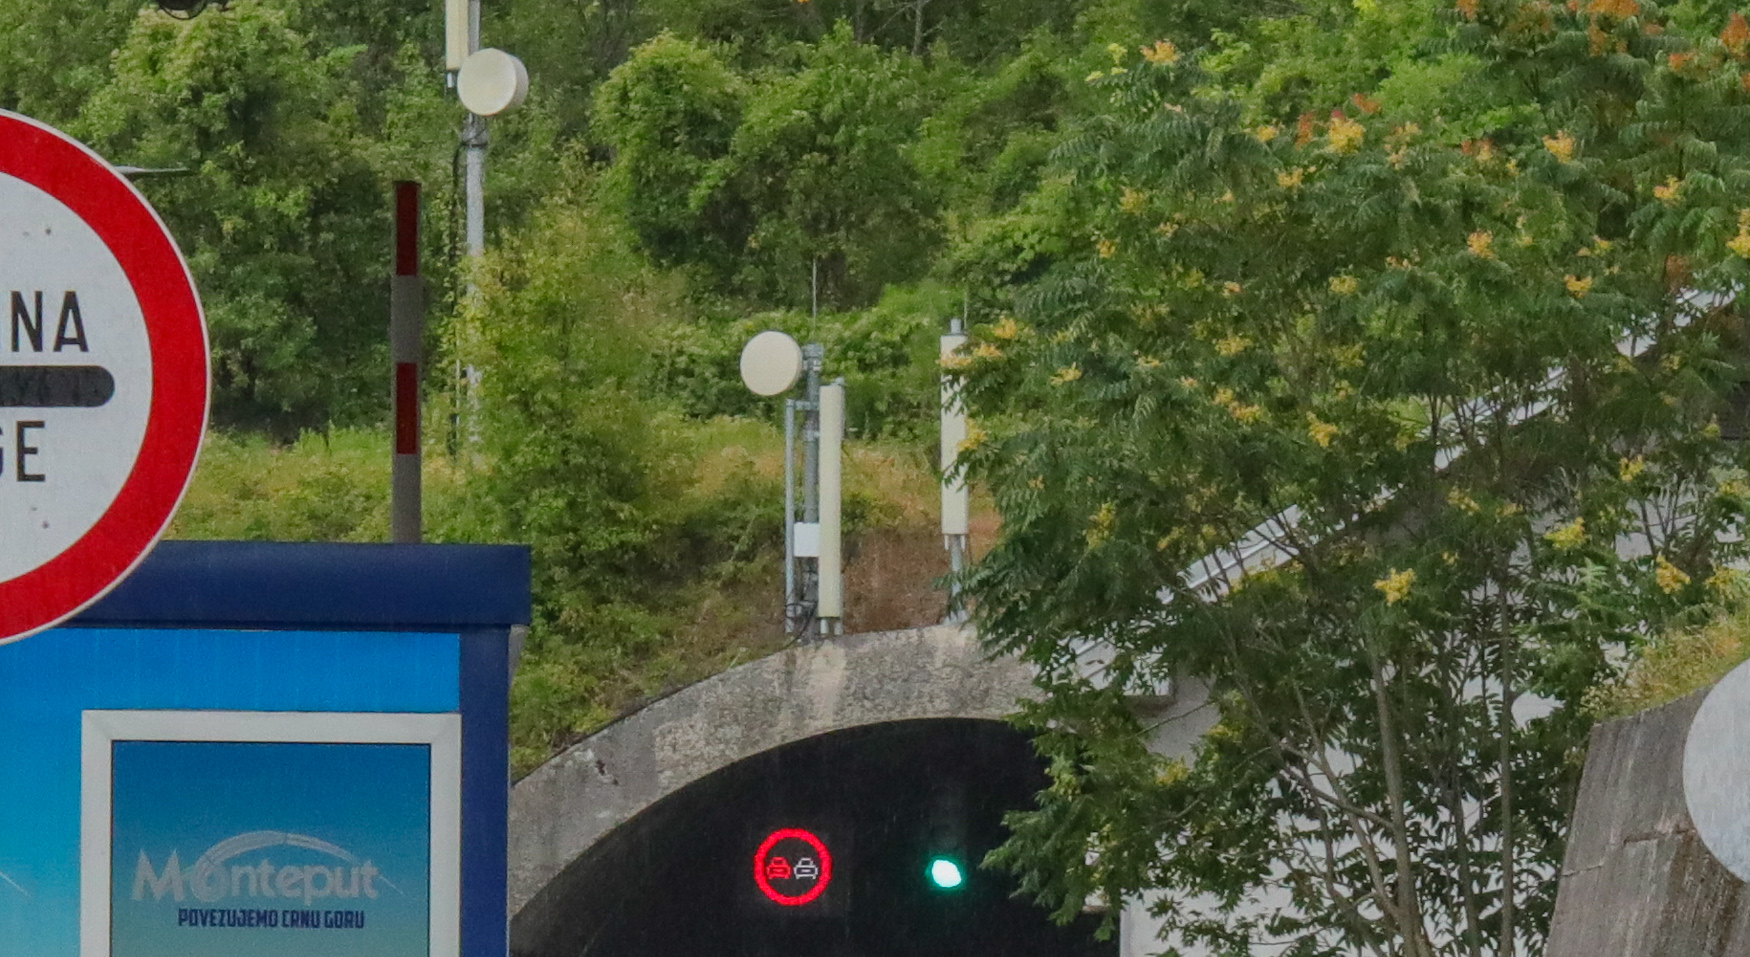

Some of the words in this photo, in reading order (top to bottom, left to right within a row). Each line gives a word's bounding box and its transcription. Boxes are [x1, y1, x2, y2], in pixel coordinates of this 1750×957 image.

[0, 420, 46, 482] E
[130, 848, 380, 907] Monteput
[178, 908, 278, 928] POVEZUJEMO
[281, 909, 320, 929] CRNU
[324, 910, 365, 929] GORU
